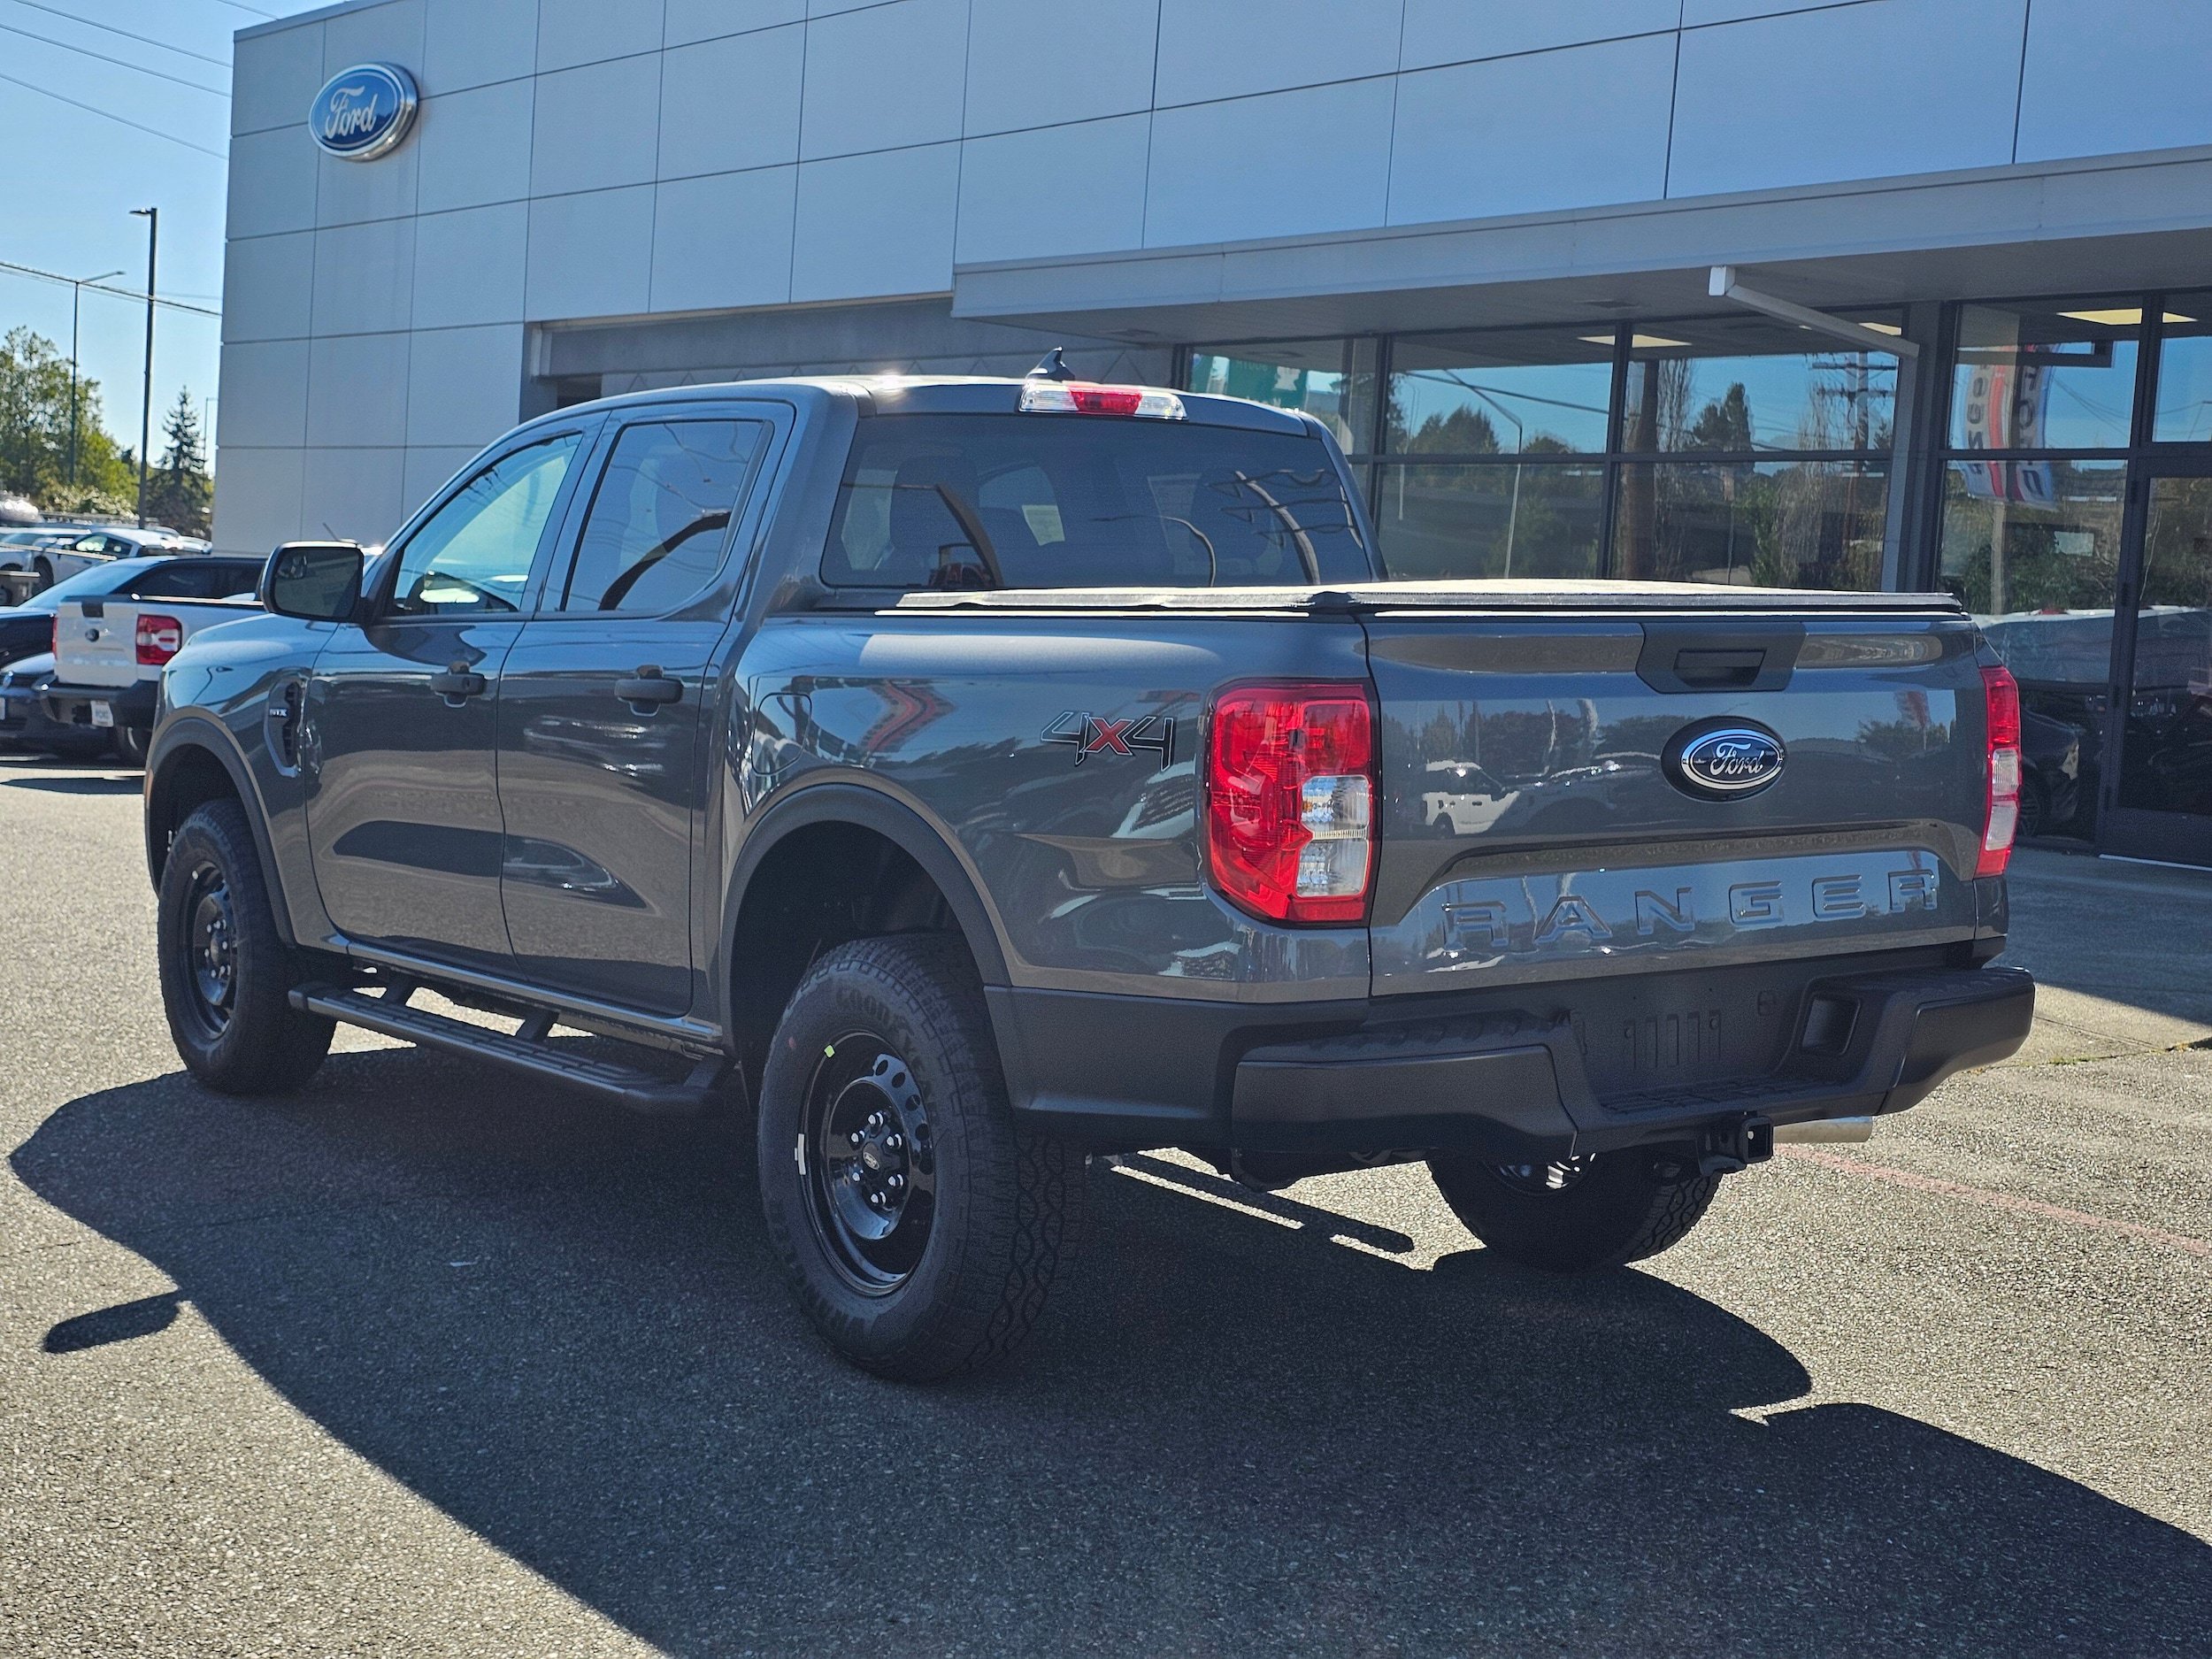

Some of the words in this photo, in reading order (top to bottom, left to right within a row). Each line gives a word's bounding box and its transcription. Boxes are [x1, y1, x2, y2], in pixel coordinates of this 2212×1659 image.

[325, 85, 379, 140] Ford
[1709, 742, 1765, 776] Ford
[1440, 868, 1939, 949] RANGER
